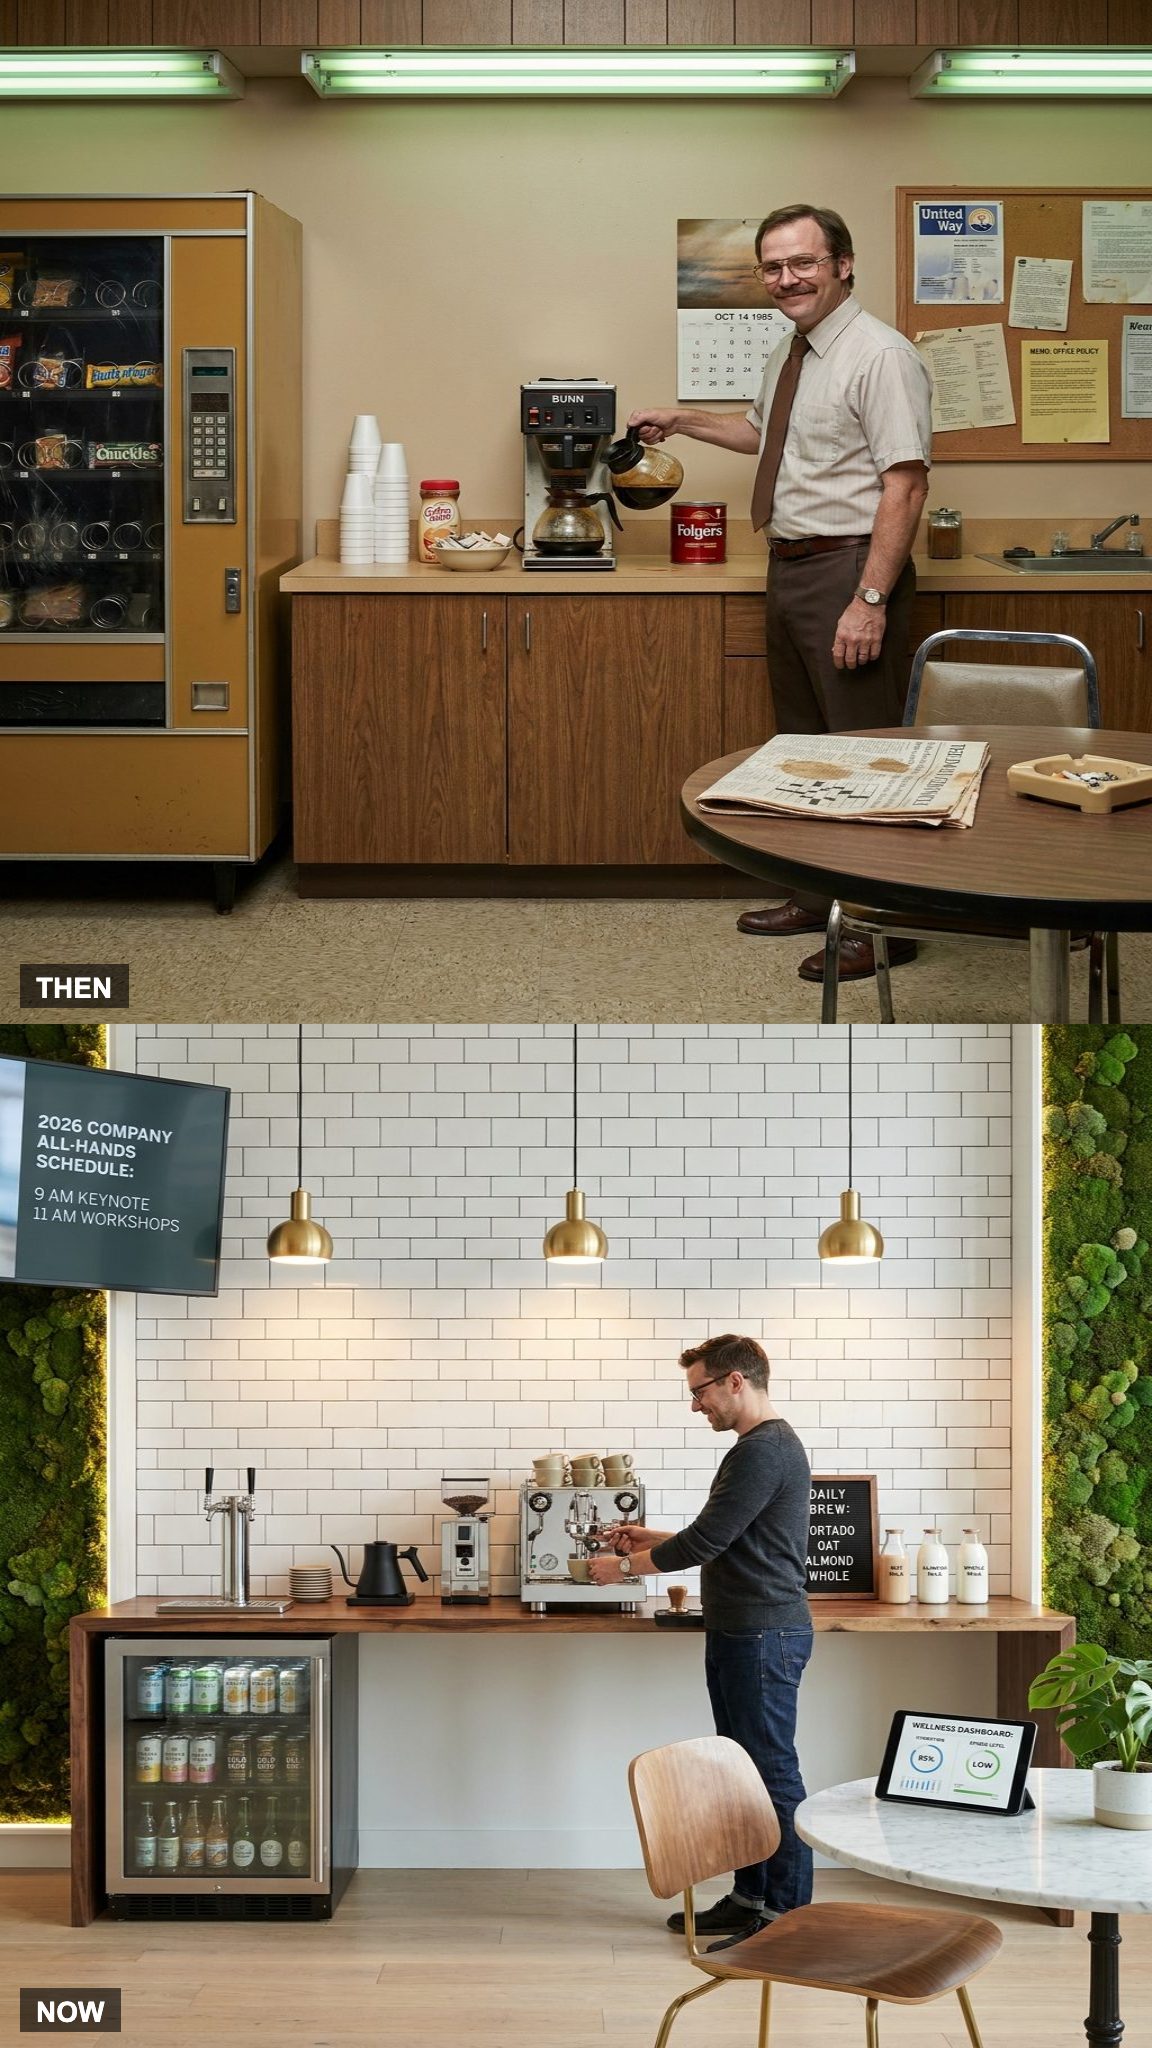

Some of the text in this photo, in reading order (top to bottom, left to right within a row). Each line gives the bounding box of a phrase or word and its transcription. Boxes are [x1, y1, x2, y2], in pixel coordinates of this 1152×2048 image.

[921, 208, 963, 220] United
[937, 220, 963, 234] Way
[1052, 347, 1075, 355] OFFICE
[1076, 347, 1099, 355] POLICY
[552, 395, 584, 403] BUNN
[677, 523, 723, 540] Folgers
[37, 1114, 173, 1144] 2026 COMPANY
[36, 1134, 136, 1159] ALL-HANDS
[36, 1154, 135, 1178] SCHEDULE:
[34, 1187, 150, 1211] 9 AM KEYNOTE
[32, 1207, 180, 1232] 11 AM WORKSHOPS
[809, 1488, 846, 1500] DAILY
[809, 1503, 850, 1514] BREW:
[809, 1525, 855, 1536] ORTADO
[817, 1540, 840, 1551] OAT
[804, 1555, 854, 1566] ALMOND
[808, 1570, 850, 1581] WHOLE
[912, 1722, 1014, 1738] WELLNESS DASHBOARD:
[972, 1761, 993, 1769] LOW
